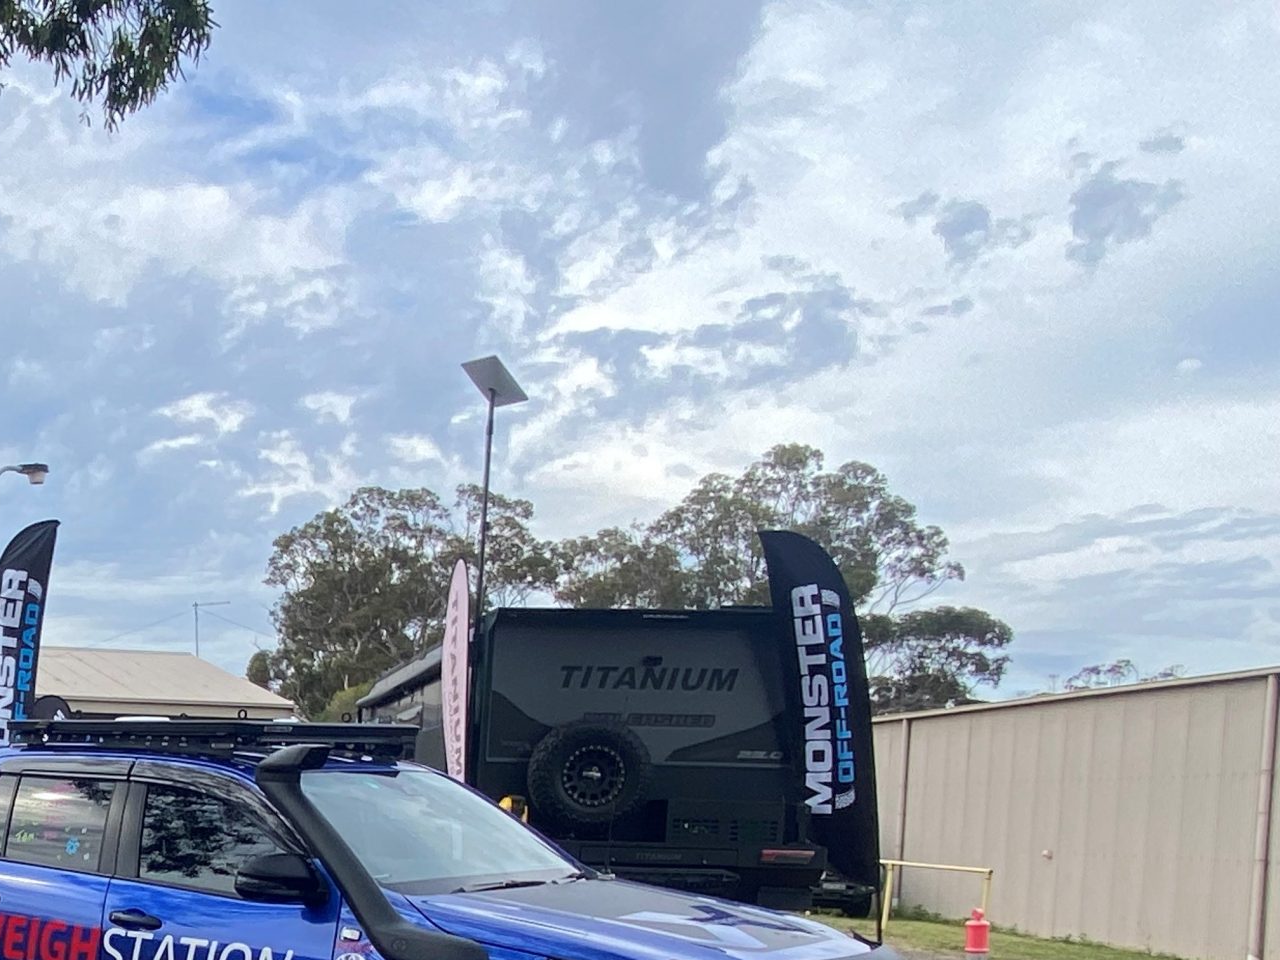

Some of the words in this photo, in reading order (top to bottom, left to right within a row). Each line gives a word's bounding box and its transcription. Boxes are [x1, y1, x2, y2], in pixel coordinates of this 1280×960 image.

[560, 665, 739, 691] TITANIUM
[791, 583, 833, 815] MONSTER
[826, 612, 855, 783] OFF-ROAD
